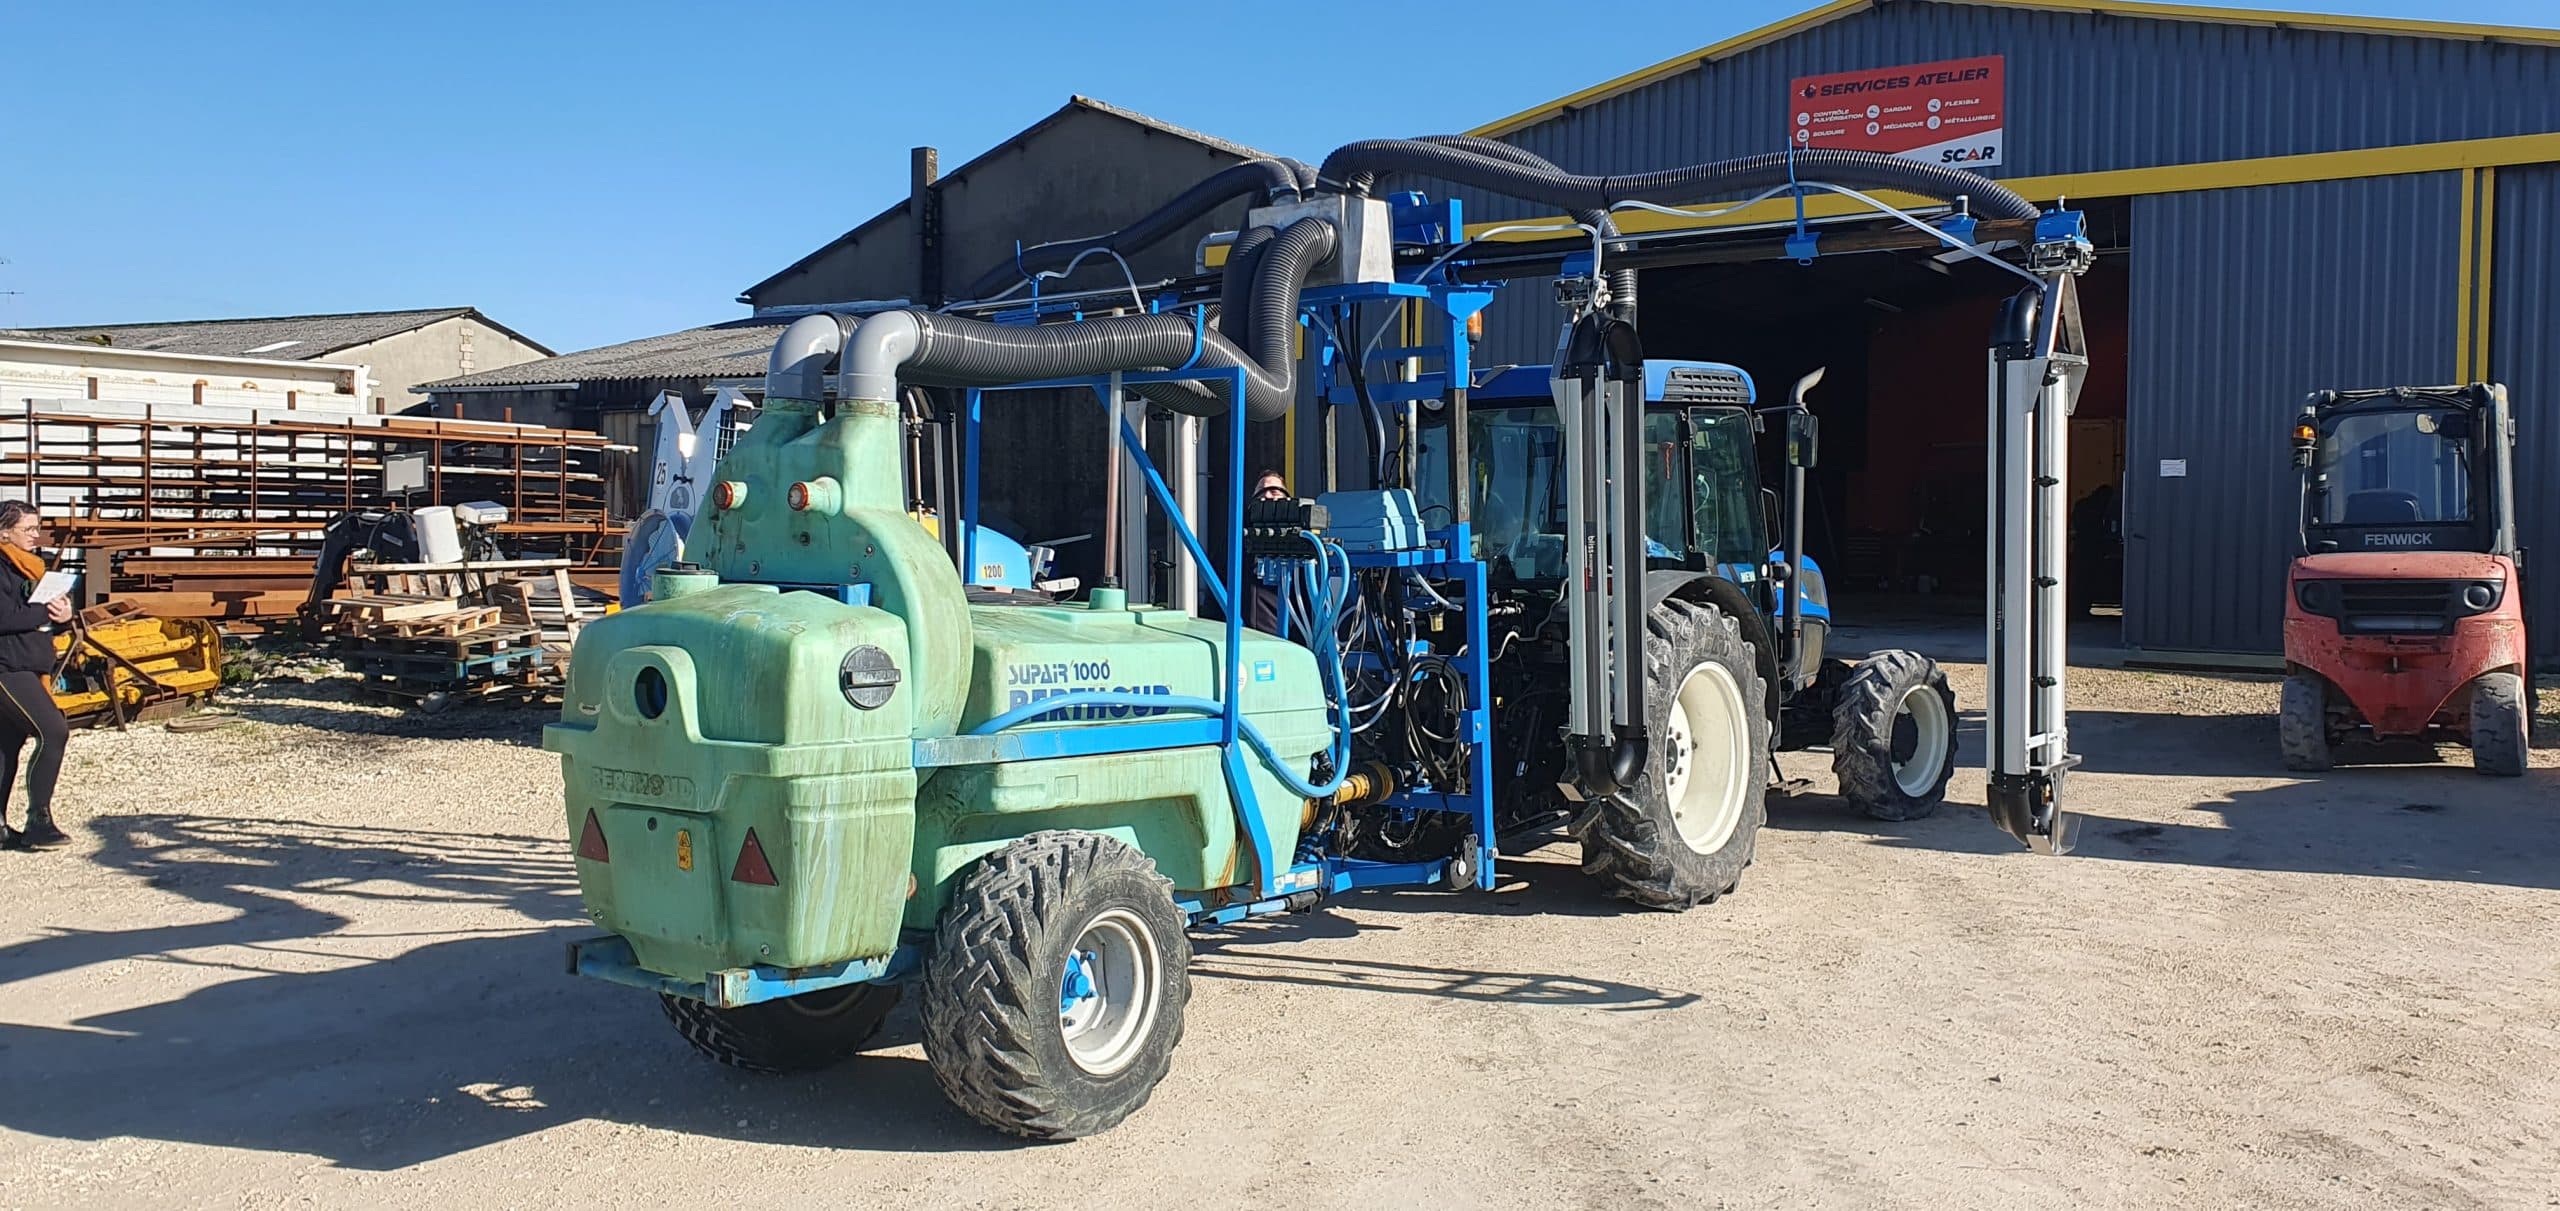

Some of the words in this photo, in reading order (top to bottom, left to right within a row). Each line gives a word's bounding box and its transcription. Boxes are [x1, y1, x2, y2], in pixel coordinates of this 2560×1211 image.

[1820, 77, 1909, 96] SERVICES
[1915, 68, 1989, 87] ATELIER
[1944, 98, 1980, 107] FLEXIBLE
[1813, 109, 1850, 118] CONTRÔLE
[1883, 105, 1912, 113] CARDAN
[1944, 114, 1996, 124] MÉTALLURGIE
[1883, 121, 1924, 130] MÉCANIQUE
[1812, 129, 1845, 137] SOUDURE
[1941, 146, 1995, 163] SCAR
[656, 462, 667, 485] 25
[1587, 535, 1596, 553] bliss
[2364, 533, 2433, 545] FENWICK
[983, 565, 1003, 578] 1200
[1073, 662, 1111, 681] 1000
